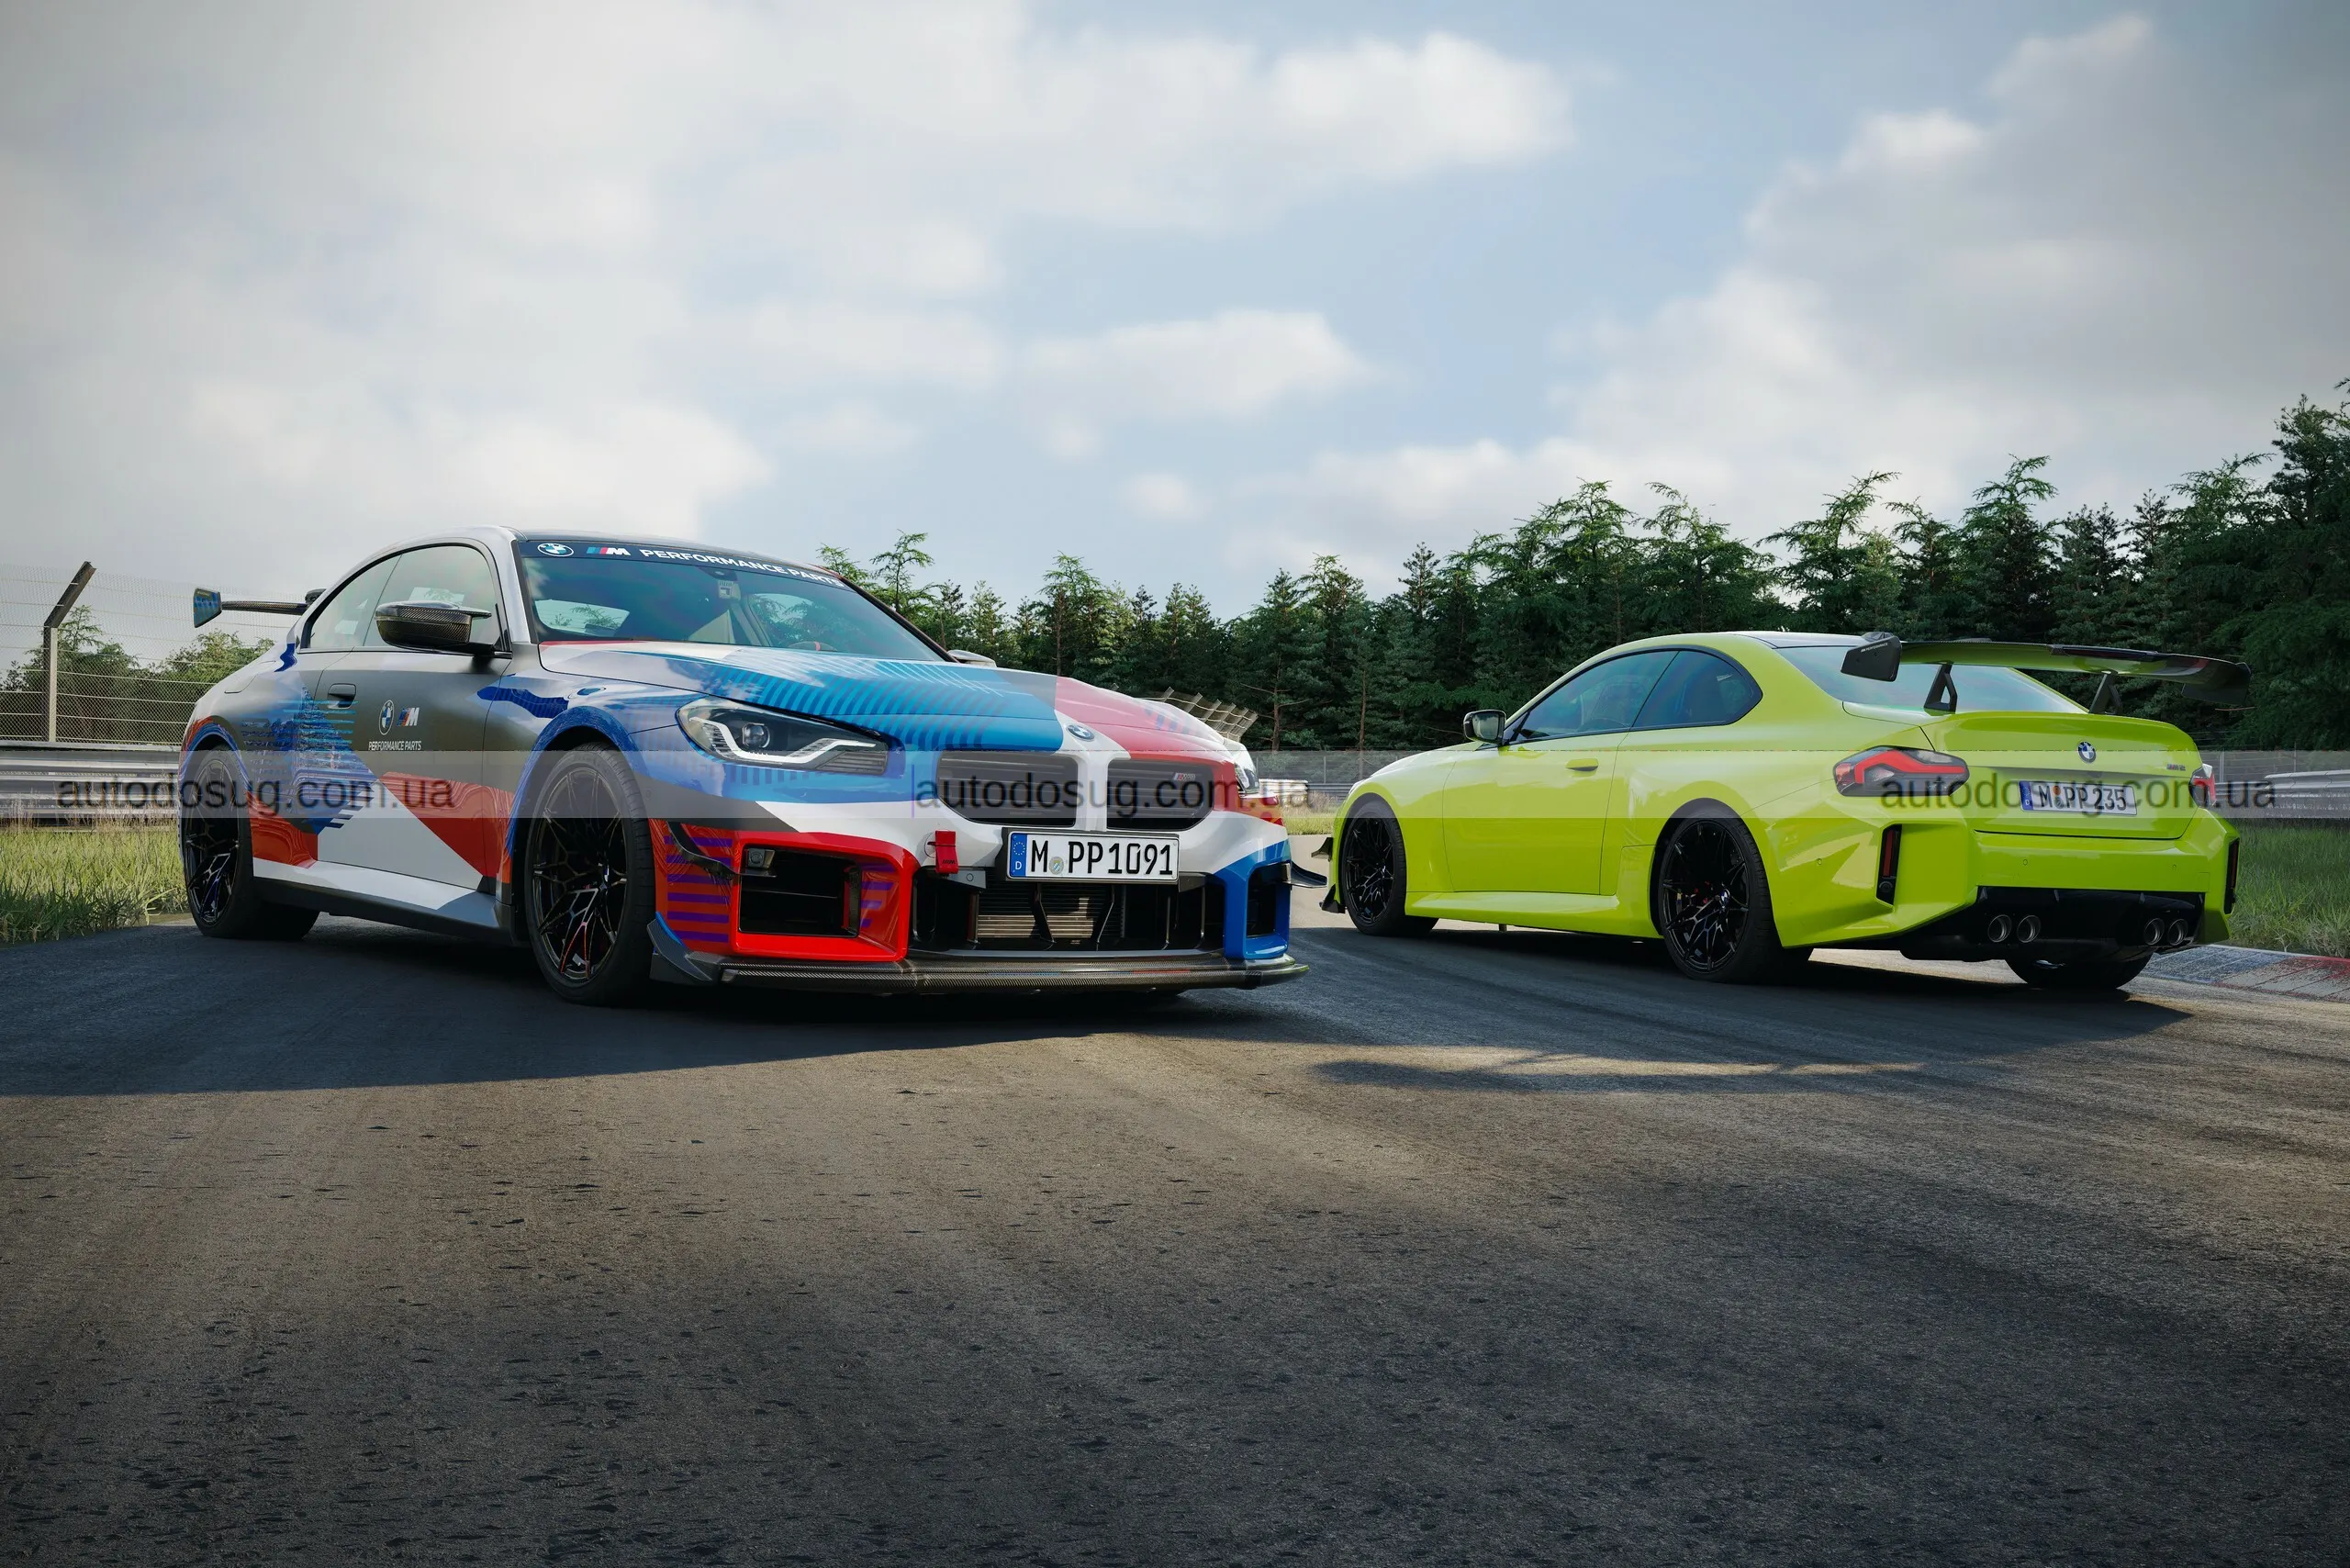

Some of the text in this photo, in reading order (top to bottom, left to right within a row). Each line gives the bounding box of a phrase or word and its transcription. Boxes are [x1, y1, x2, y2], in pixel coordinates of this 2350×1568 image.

[639, 549, 789, 575] PERFORMANCE
[787, 568, 845, 588] PARTS
[368, 741, 421, 751] PERFORMANCE PARTS
[2039, 785, 2053, 808] M
[2093, 788, 2126, 811] 235
[1015, 861, 1023, 870] D
[1031, 840, 1049, 873] M
